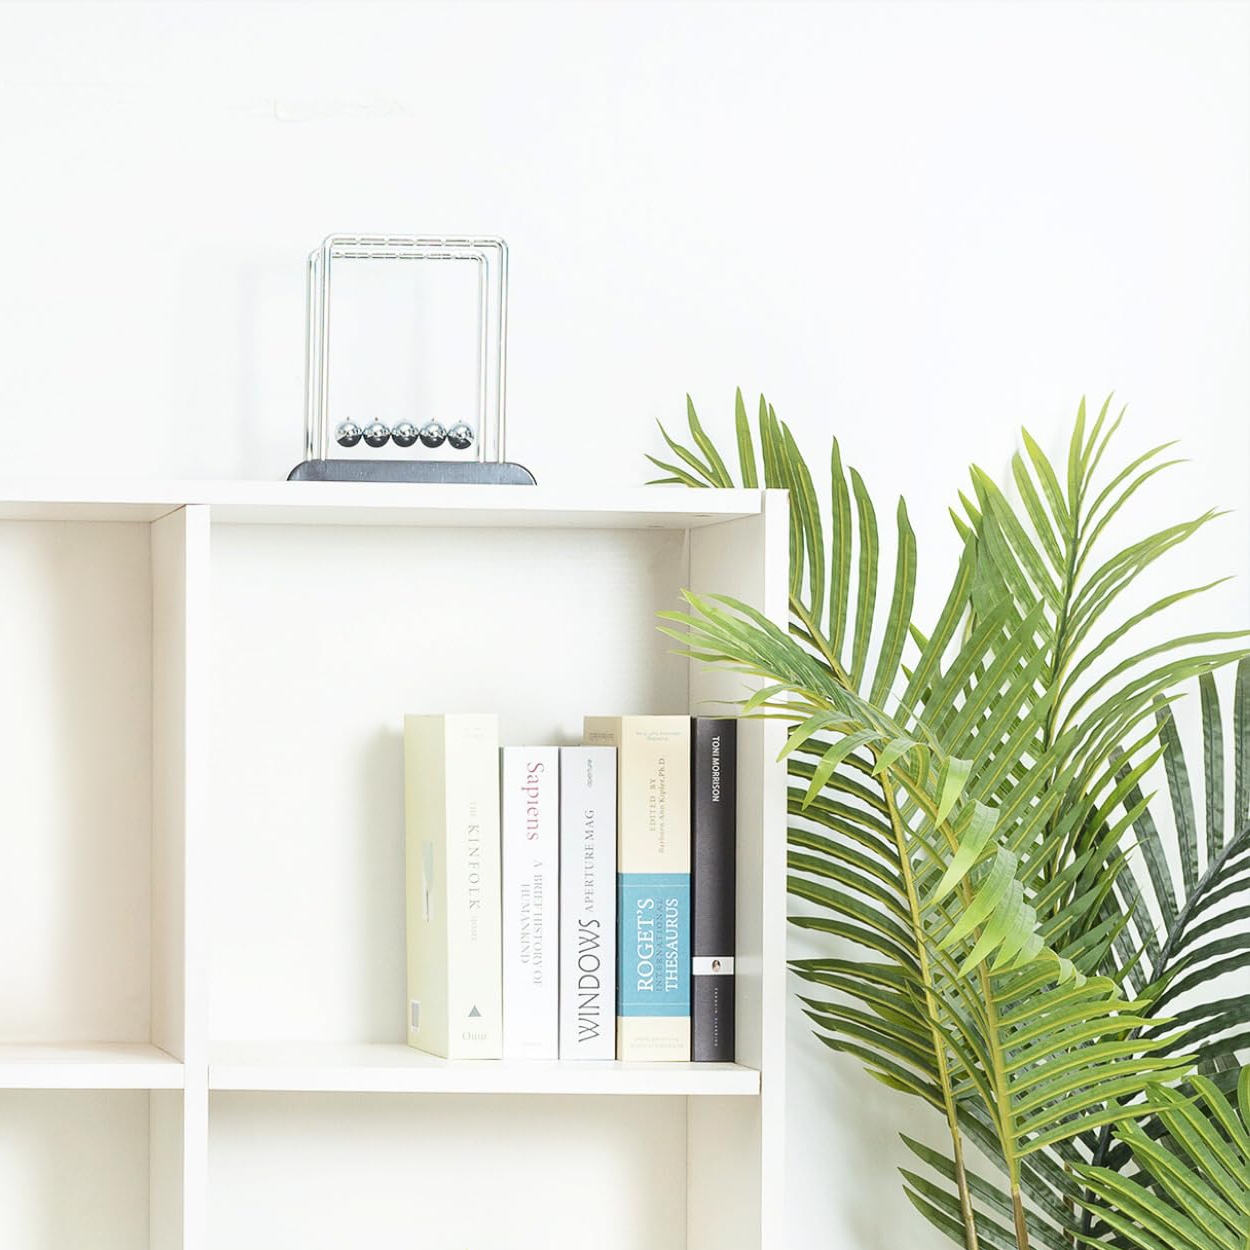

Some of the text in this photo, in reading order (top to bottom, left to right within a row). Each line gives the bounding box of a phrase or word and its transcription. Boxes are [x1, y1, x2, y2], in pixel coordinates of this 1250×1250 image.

[520, 762, 544, 841] Sapiens
[712, 736, 720, 802] TONI MORRISON
[468, 824, 482, 909] KINFOLK
[584, 809, 594, 912] APERTURE MAG
[521, 884, 531, 964] HUMANKIND
[534, 859, 542, 987] A BRIEF HISTORY OF
[637, 898, 655, 992] ROGET'S
[665, 898, 678, 992] THESAURUS
[578, 919, 601, 1043] WINDOWS
